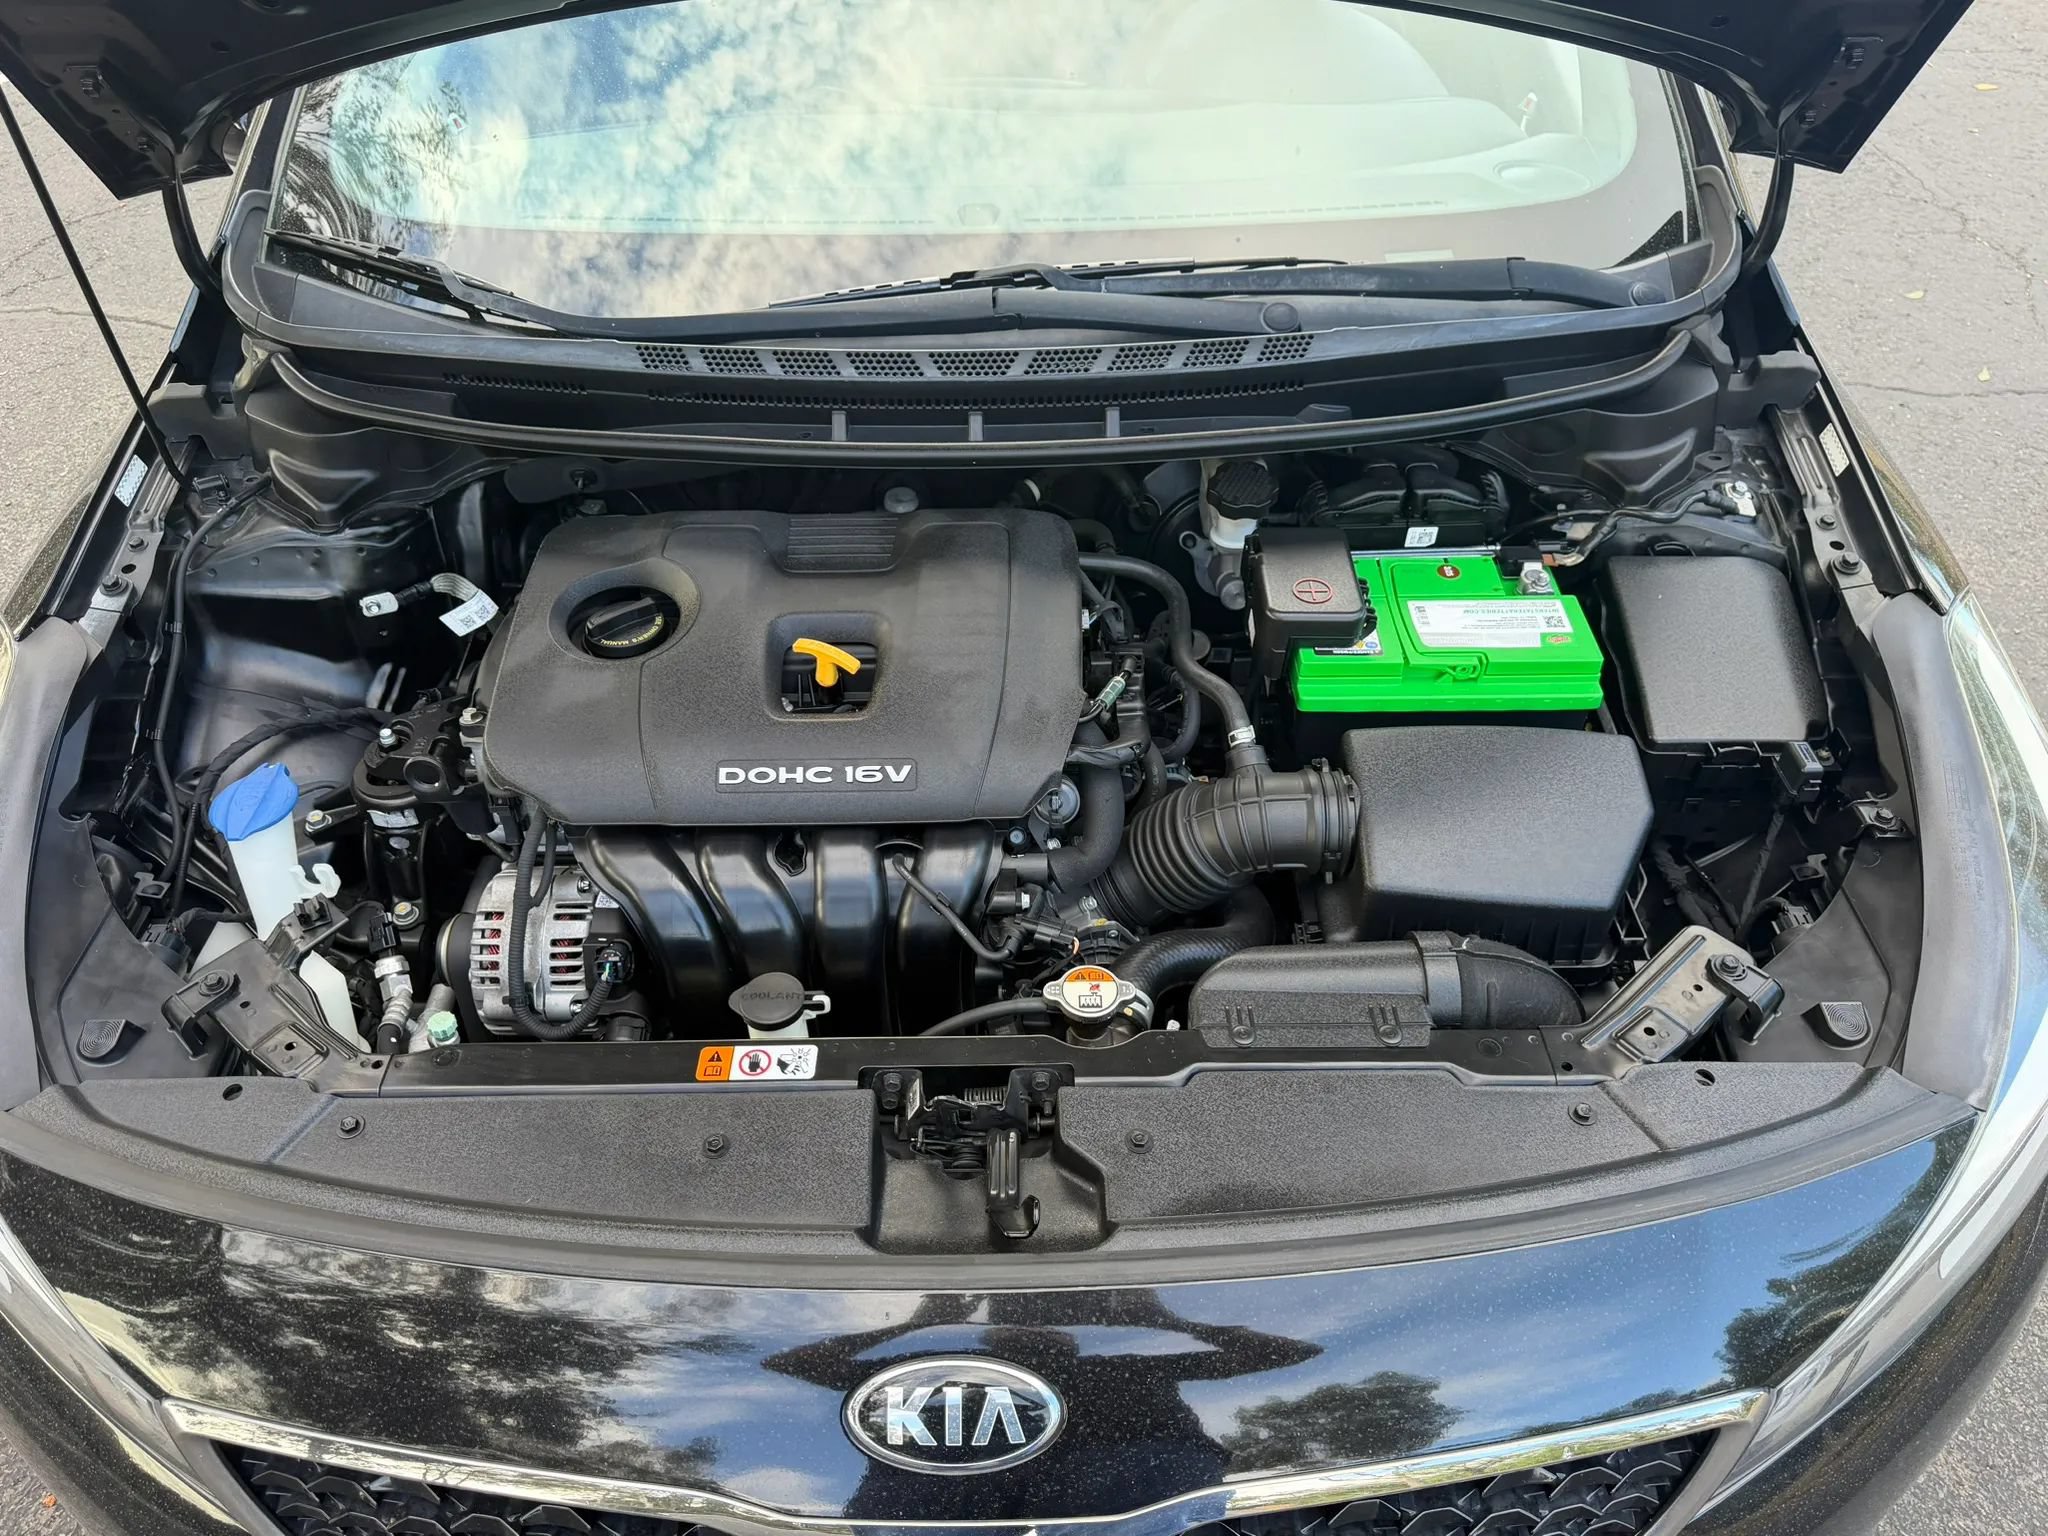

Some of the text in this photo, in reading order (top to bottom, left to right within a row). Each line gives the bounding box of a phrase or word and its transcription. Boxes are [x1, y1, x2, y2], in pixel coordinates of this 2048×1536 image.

[718, 764, 912, 784] DOHC 16V
[741, 991, 801, 1000] COOLANT
[885, 1386, 1026, 1446] KIA
